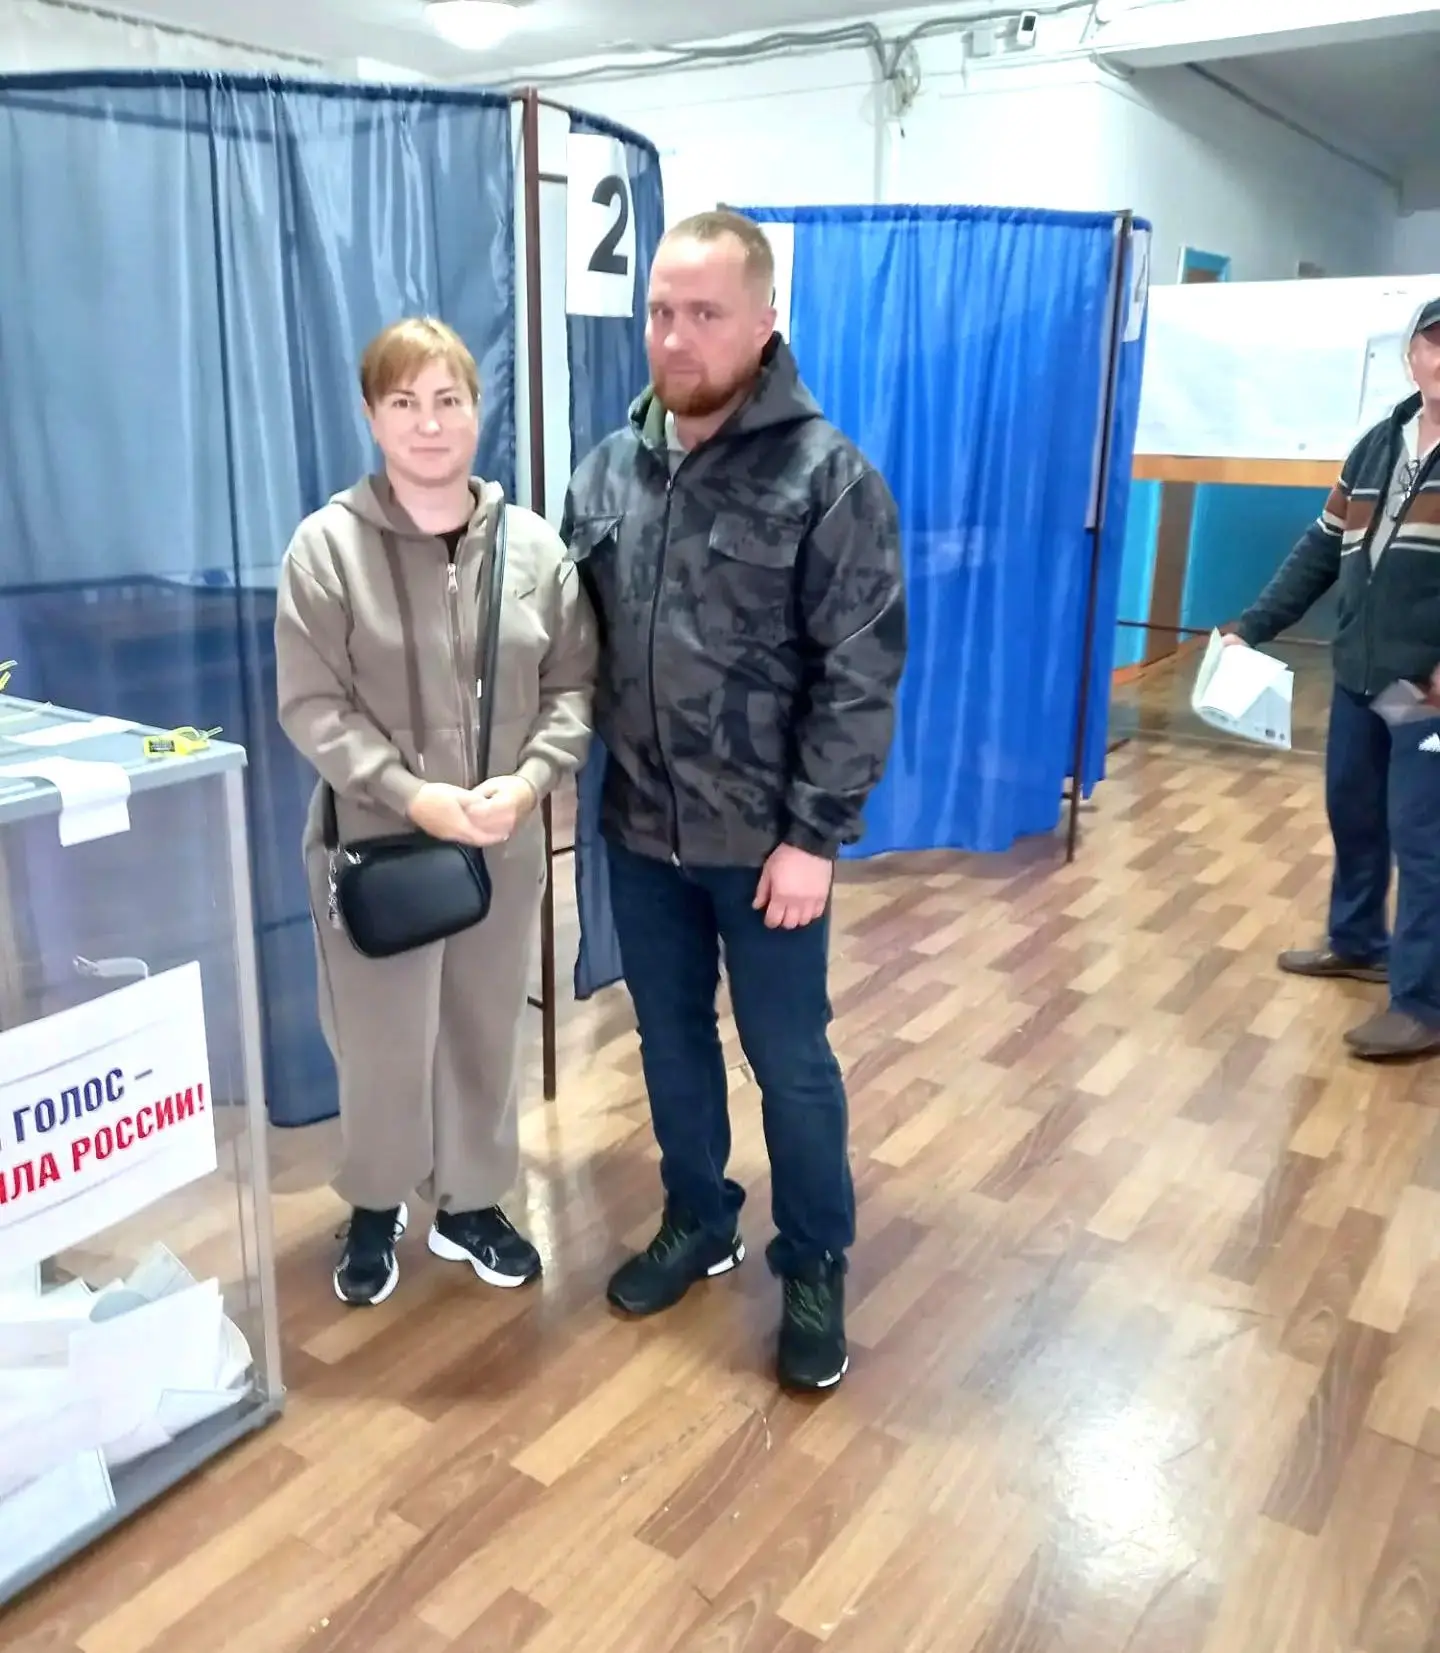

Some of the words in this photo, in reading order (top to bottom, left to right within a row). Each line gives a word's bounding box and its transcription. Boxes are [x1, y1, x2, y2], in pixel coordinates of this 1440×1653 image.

[588, 175, 628, 275] 2
[13, 1067, 125, 1142] ГОЛОС
[71, 1083, 205, 1172] РОССИИ!
